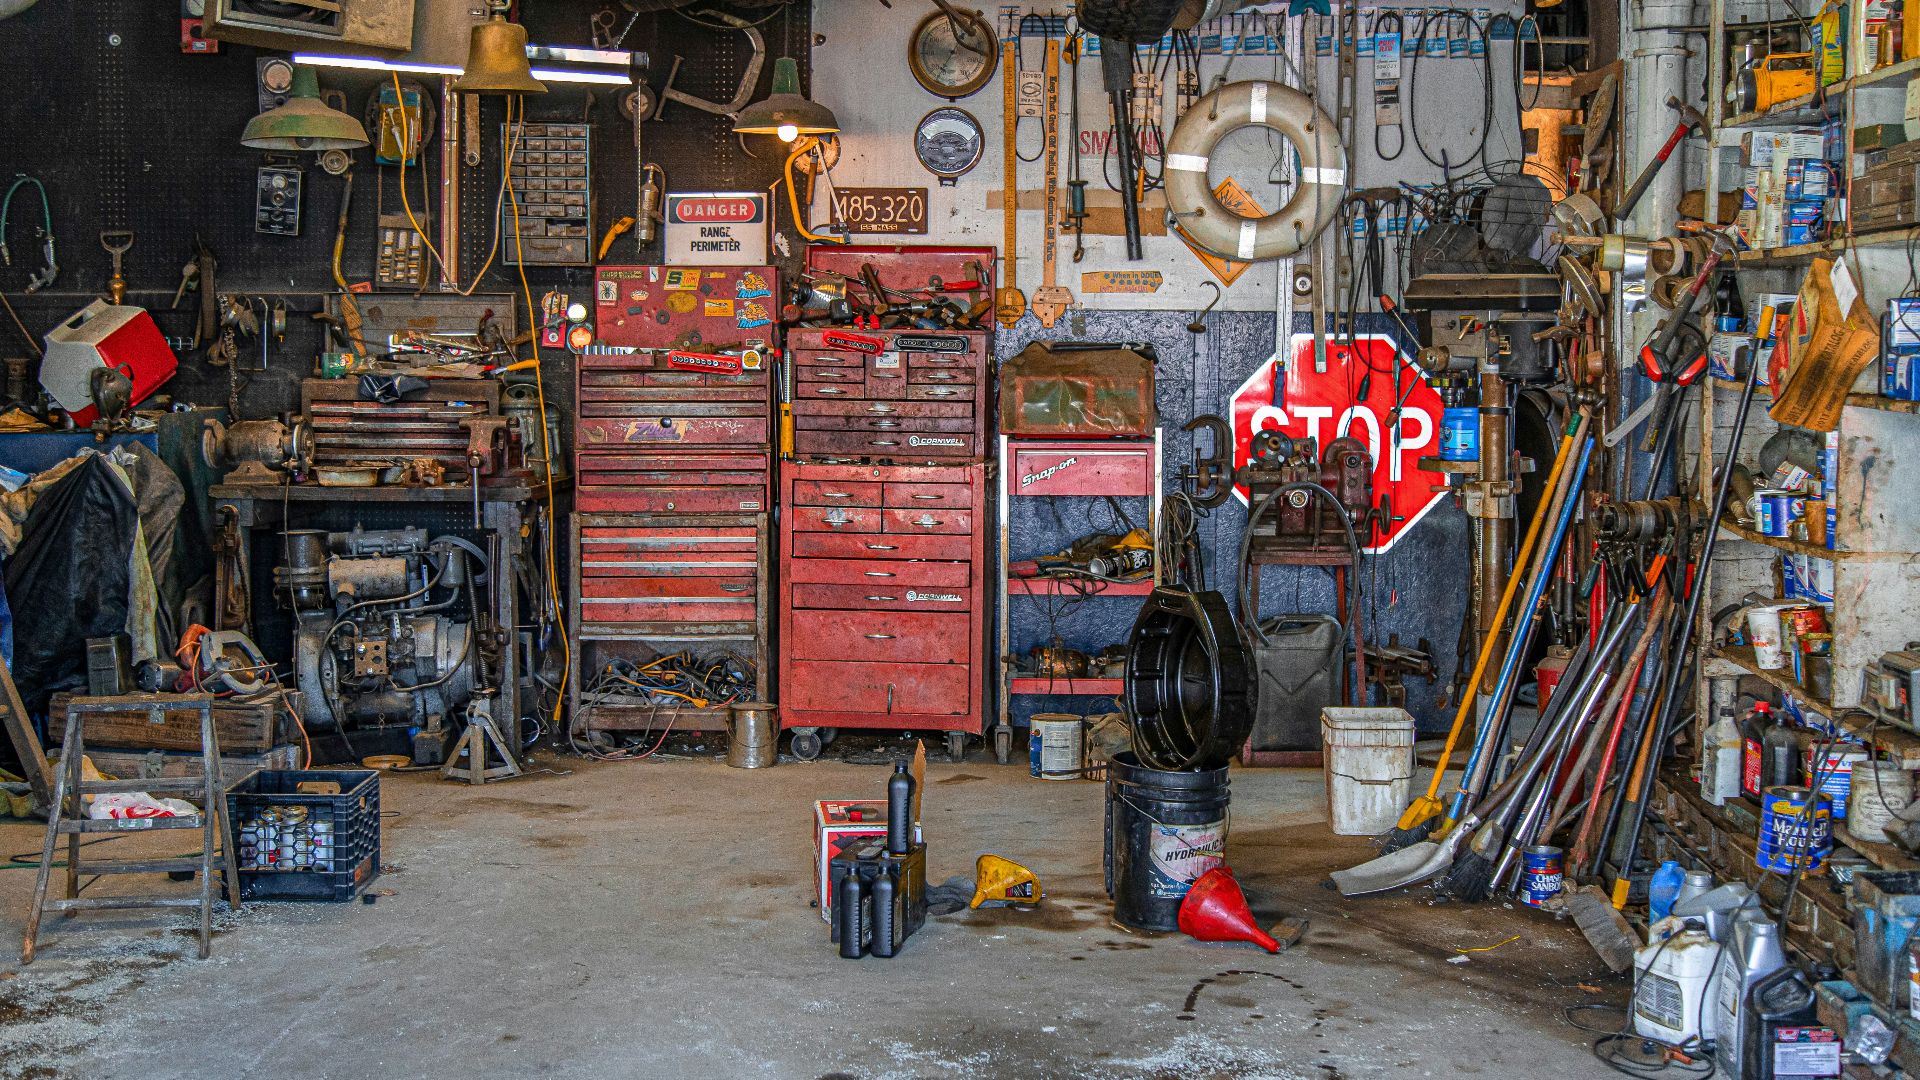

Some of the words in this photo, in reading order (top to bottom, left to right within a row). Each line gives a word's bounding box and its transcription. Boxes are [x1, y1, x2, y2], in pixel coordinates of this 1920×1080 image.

[1047, 76, 1057, 94] Keep
[1048, 95, 1057, 113] That
[1048, 115, 1057, 133] Great
[1047, 177, 1056, 194] With
[683, 204, 748, 217] DANGER
[1047, 196, 1056, 226] Genuine
[700, 226, 731, 238] RANGE
[690, 240, 741, 252] PERIMETER
[920, 437, 965, 445] CORNWELL
[1022, 457, 1077, 488] Snap-on
